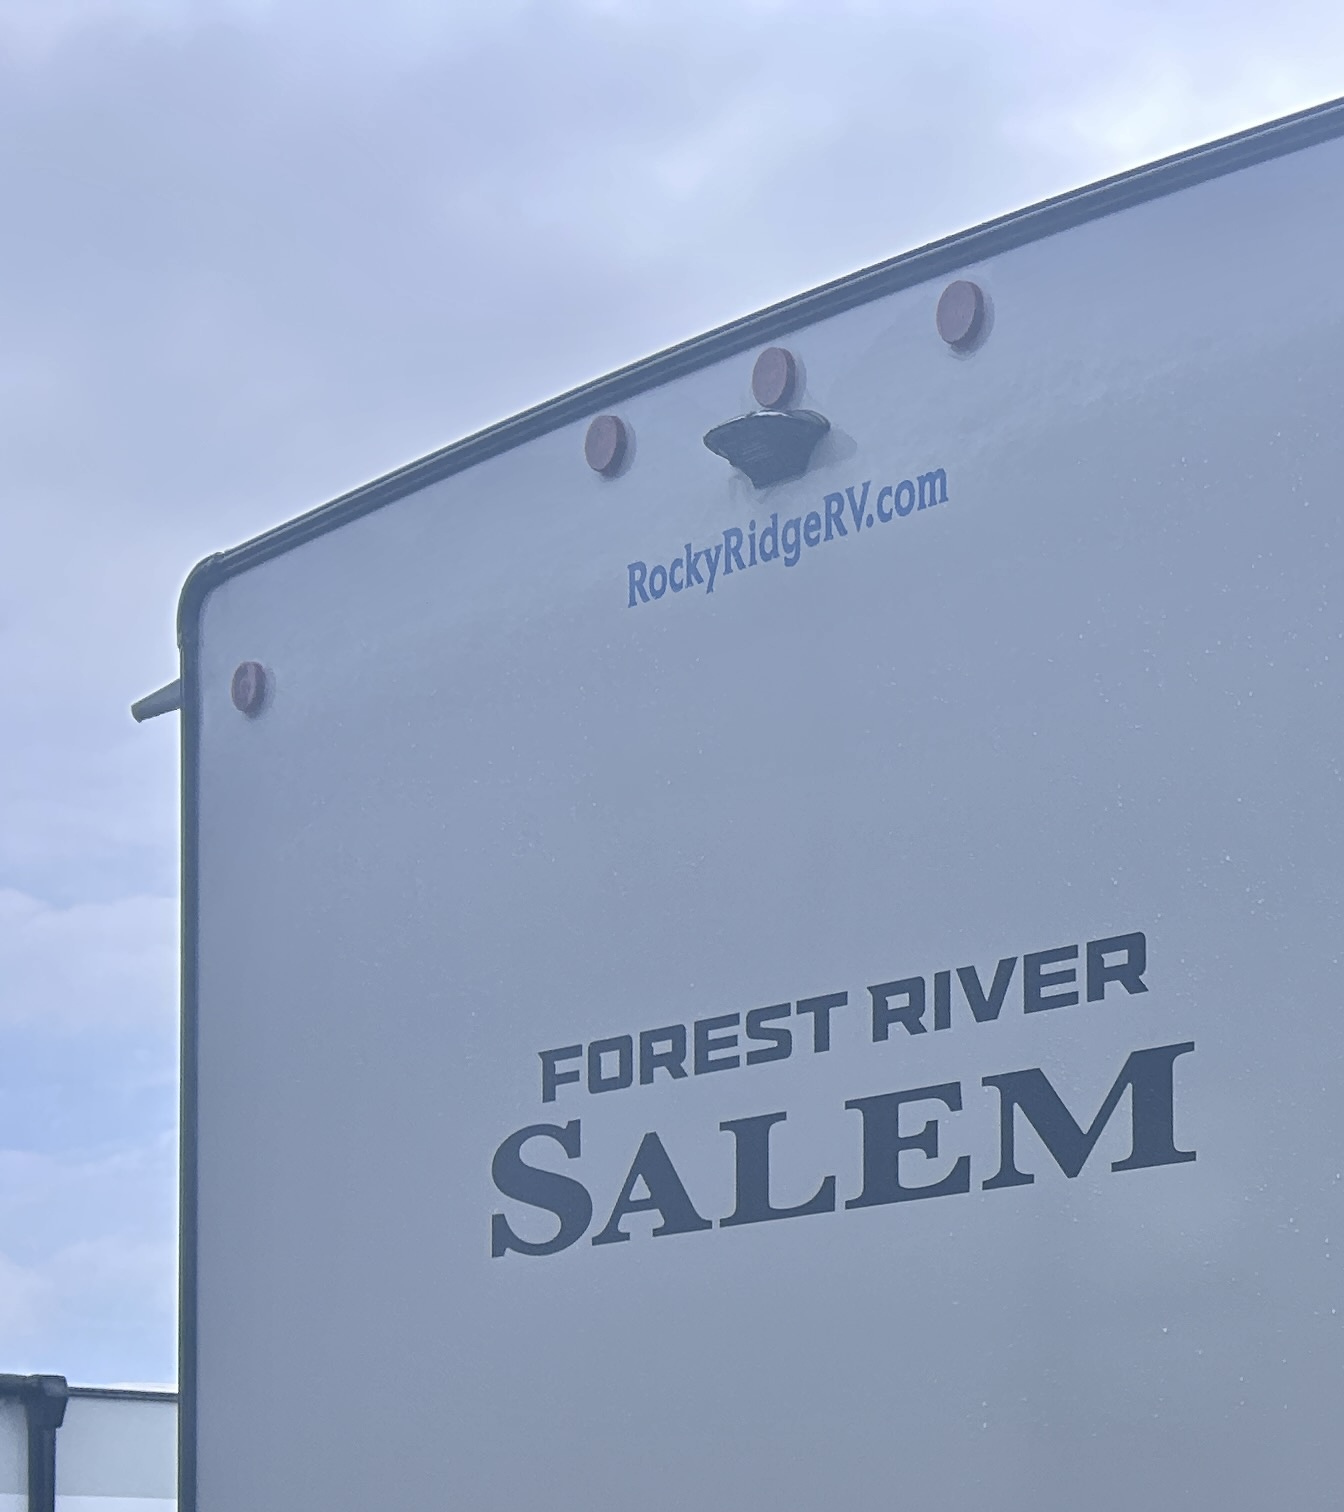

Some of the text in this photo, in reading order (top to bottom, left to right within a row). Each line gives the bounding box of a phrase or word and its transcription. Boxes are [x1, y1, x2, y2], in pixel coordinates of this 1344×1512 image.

[627, 467, 949, 608] RockyRidgeRV.com
[537, 931, 1149, 1103] FOREST RIVER
[491, 1041, 1197, 1258] SALEM
